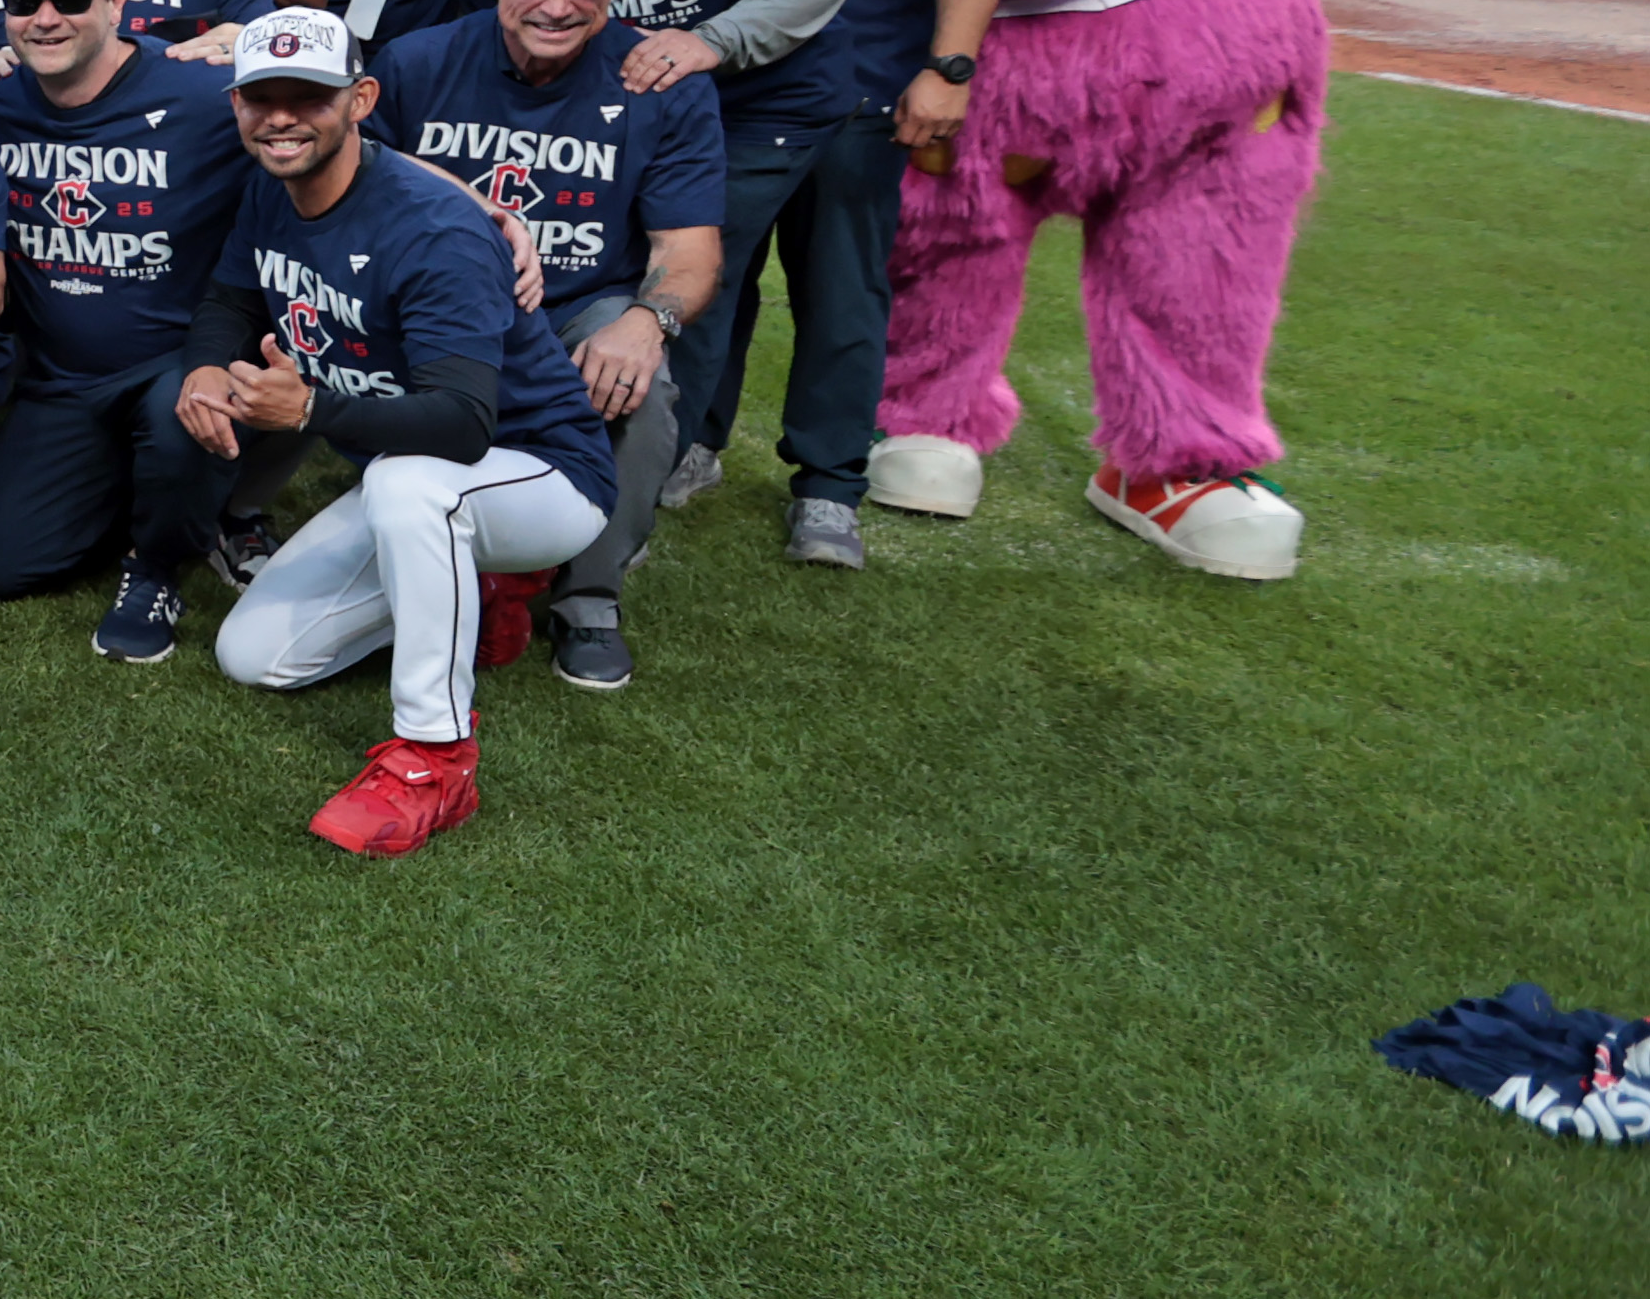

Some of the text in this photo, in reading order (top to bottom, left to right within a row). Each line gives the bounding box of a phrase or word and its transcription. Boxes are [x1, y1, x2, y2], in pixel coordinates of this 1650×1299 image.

[242, 24, 336, 55] CHAMPIONS
[1, 142, 168, 189] DIVISION
[417, 121, 617, 181] DIVISION
[53, 179, 89, 228] C
[110, 263, 172, 280] CENTRAL
